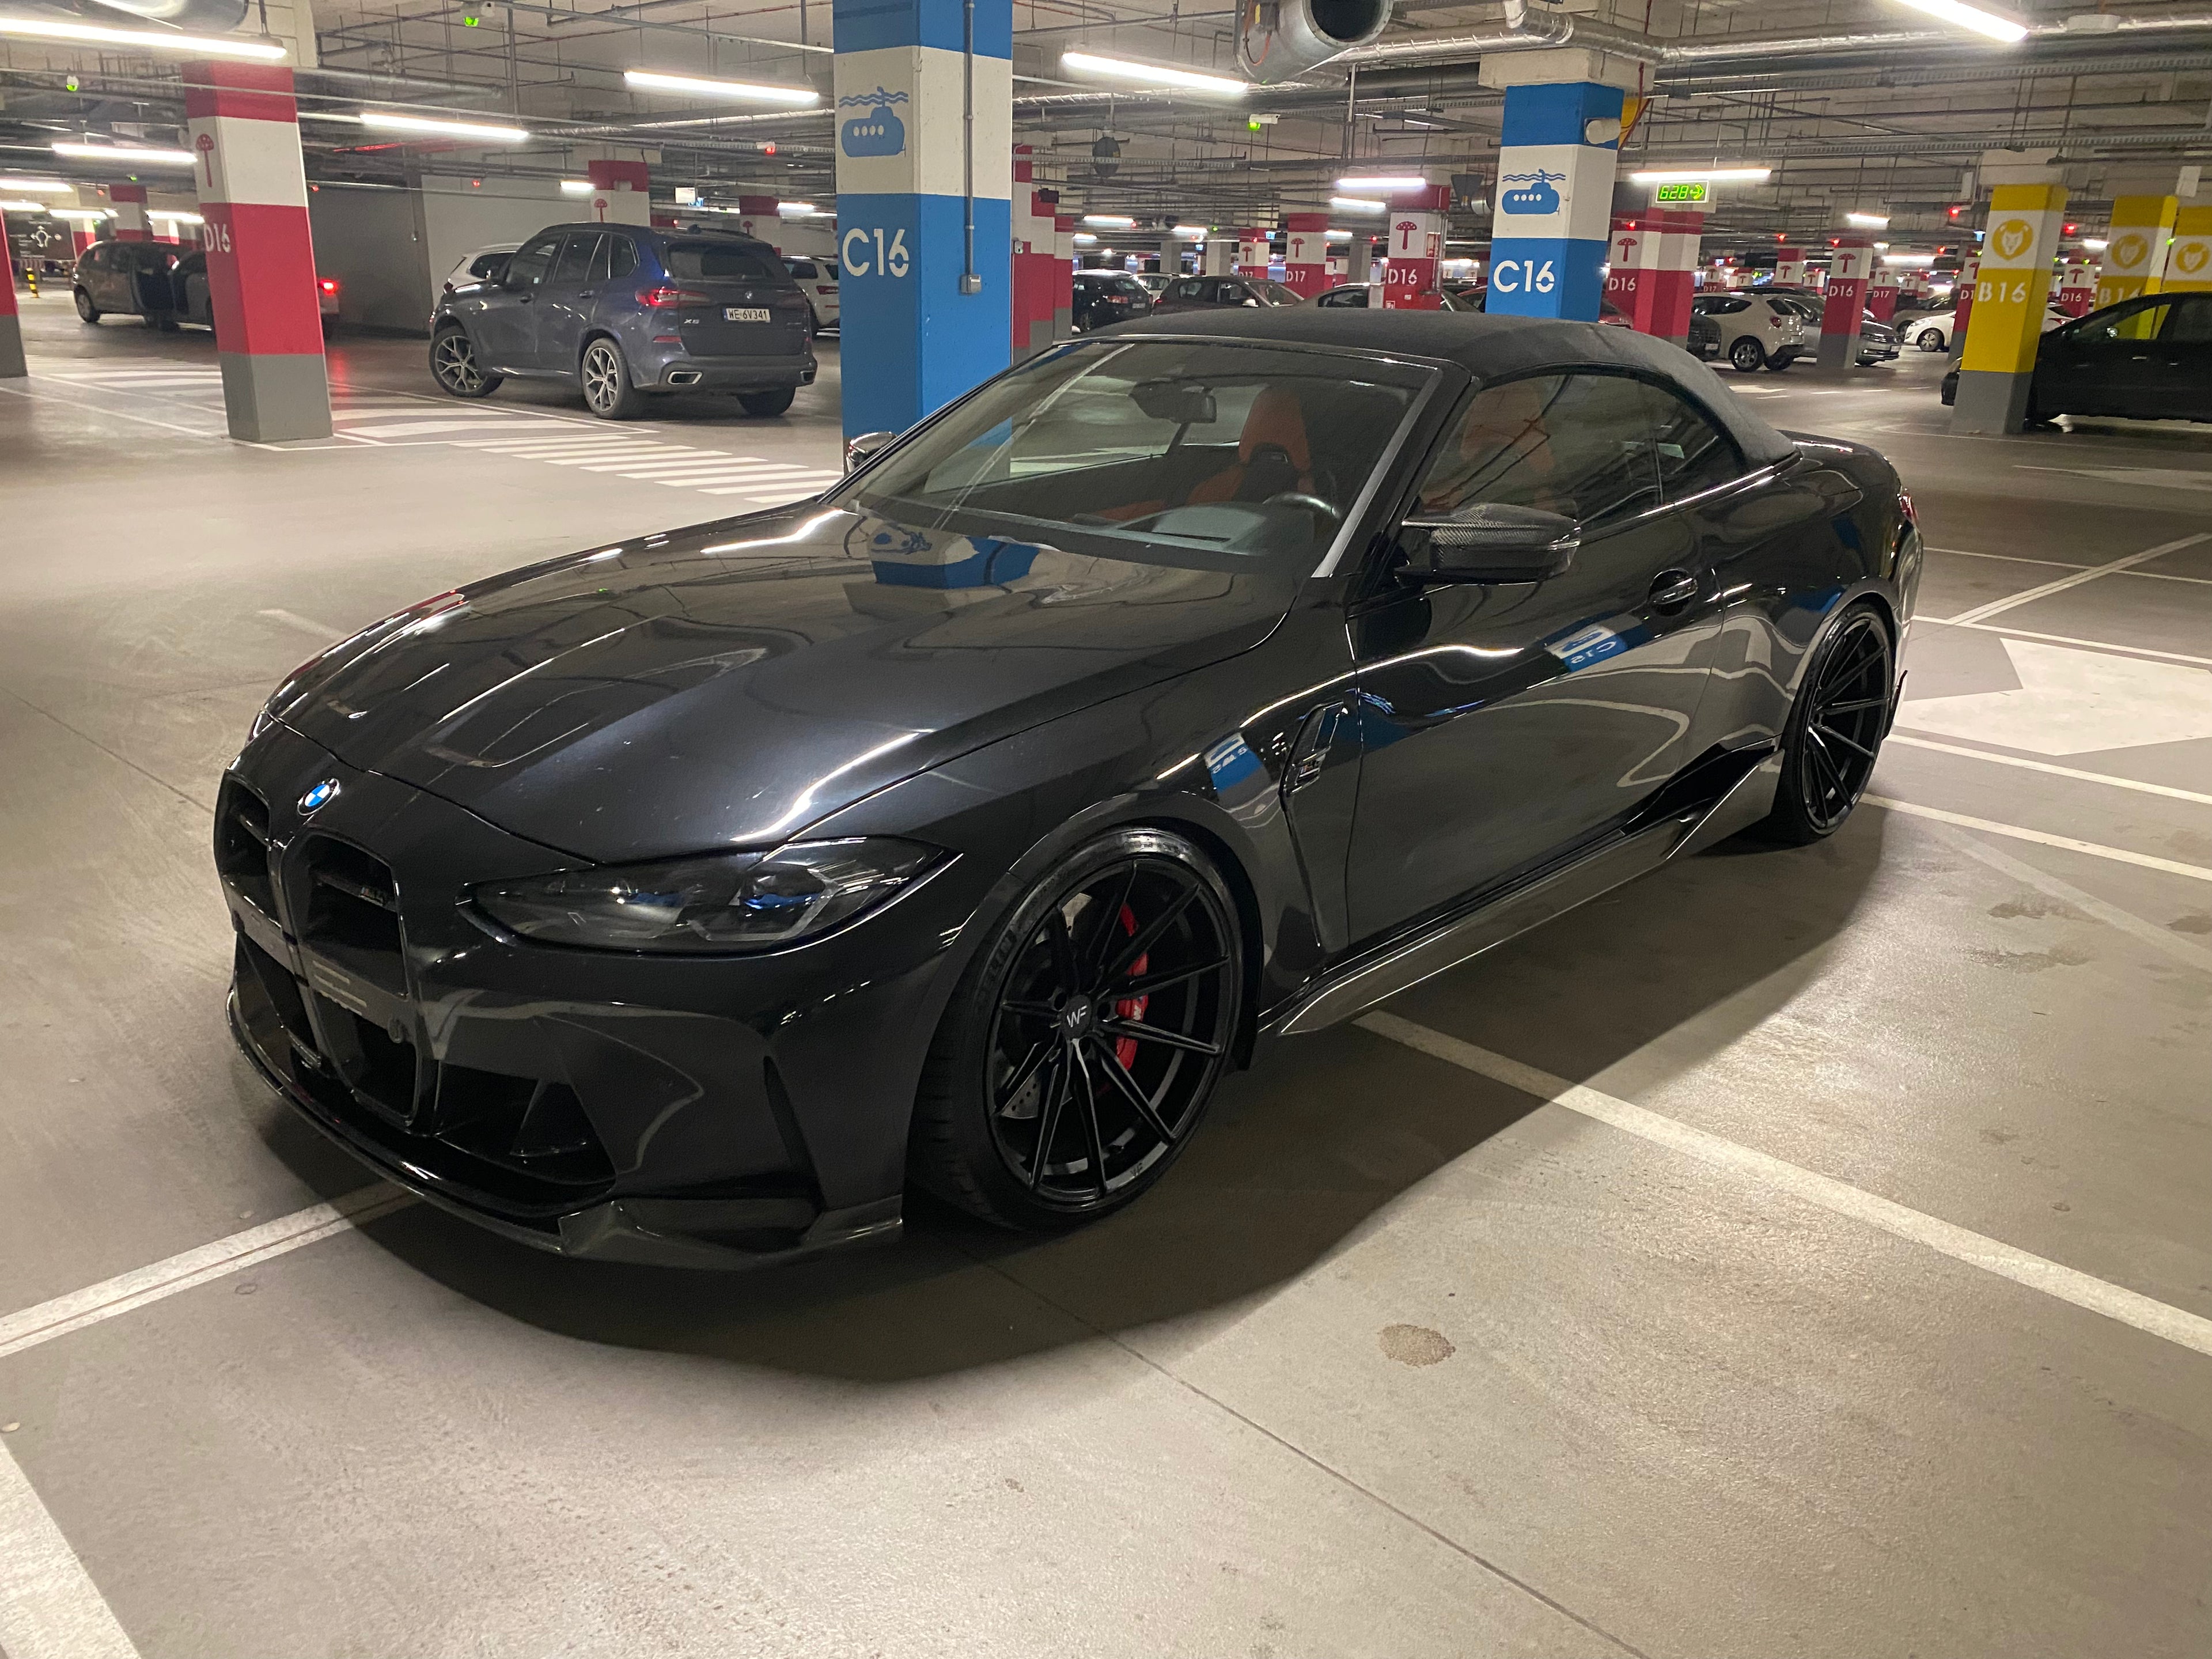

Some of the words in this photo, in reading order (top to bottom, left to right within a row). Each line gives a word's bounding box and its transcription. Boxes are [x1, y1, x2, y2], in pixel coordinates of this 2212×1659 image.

[1660, 185, 1689, 199] 628
[203, 223, 230, 253] D16
[842, 228, 909, 278] C16
[1286, 271, 1306, 282] D17
[1388, 268, 1417, 285] D16
[1493, 260, 1555, 293] C16
[1608, 277, 1636, 291] D16
[1828, 285, 1853, 297] D16
[1960, 290, 1974, 300] D1
[1978, 281, 2026, 303] B16
[2061, 293, 2082, 302] D16
[728, 309, 740, 319] WE
[743, 310, 767, 320] 6V341
[1067, 1005, 1087, 1027] WF
